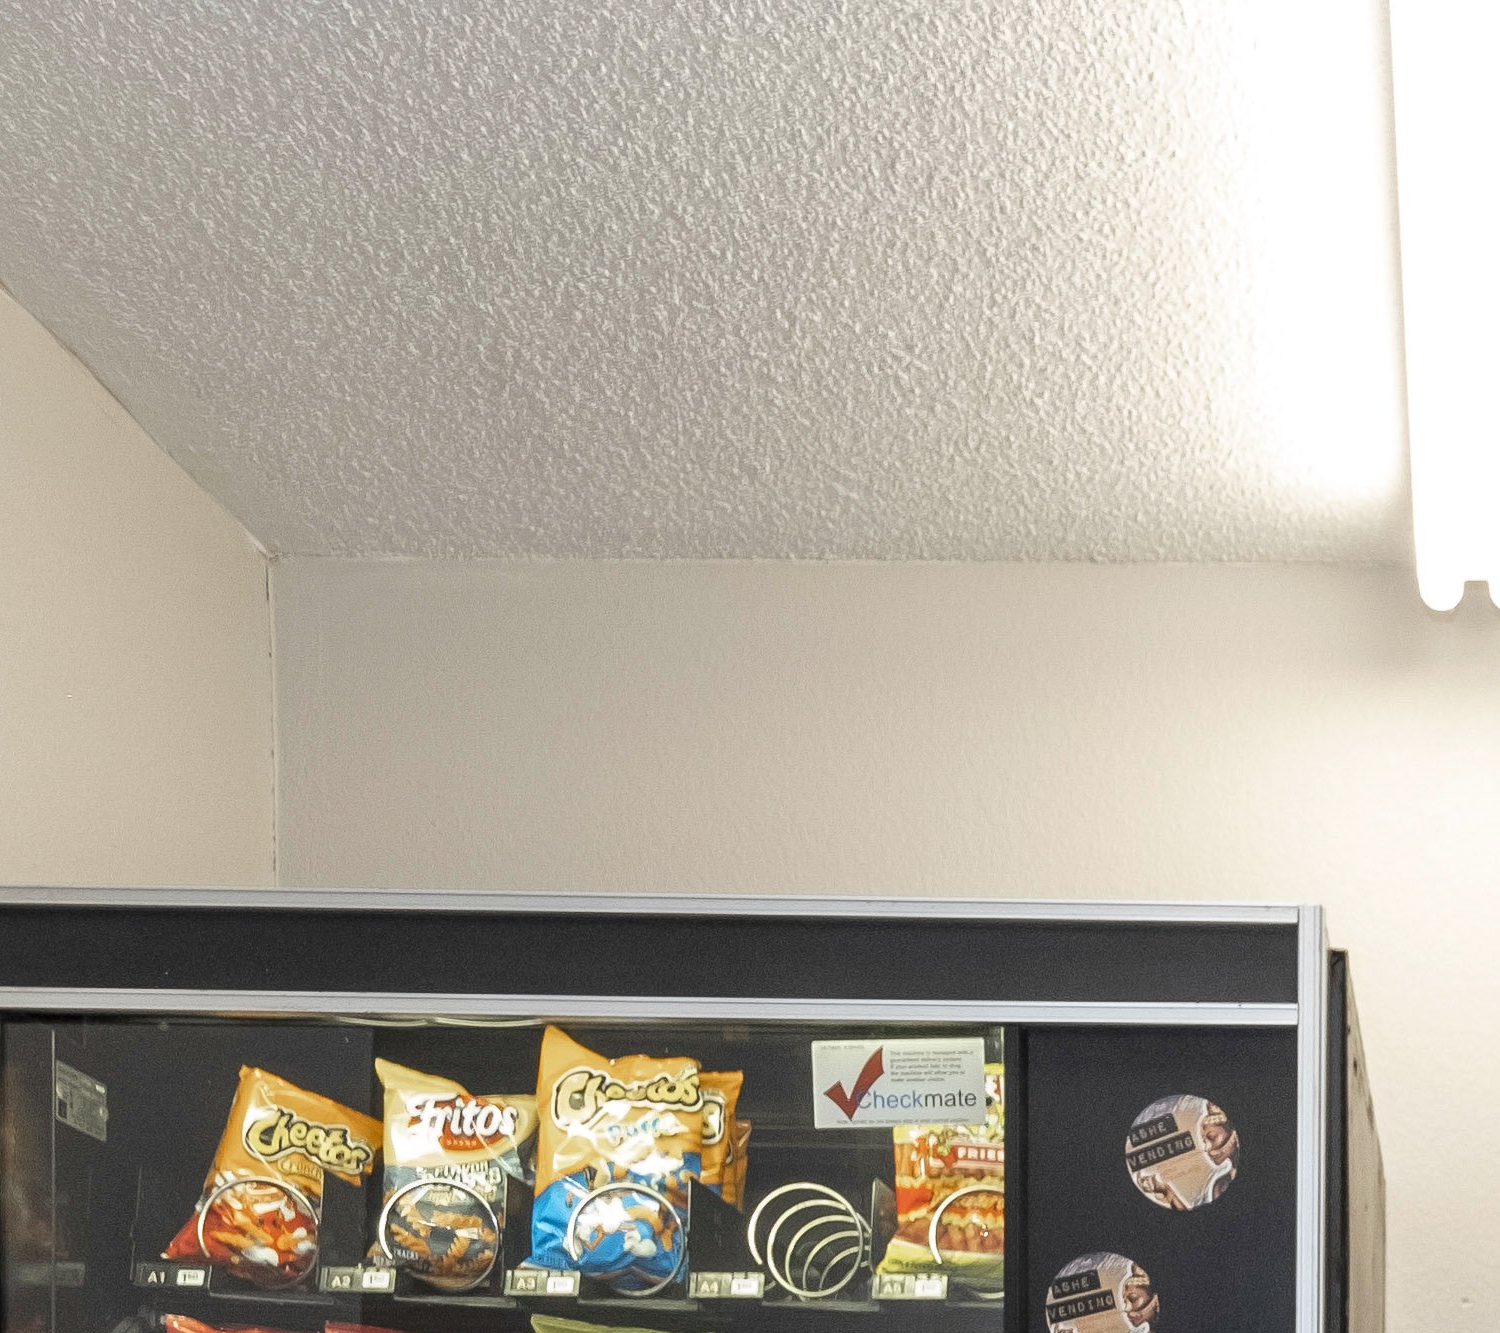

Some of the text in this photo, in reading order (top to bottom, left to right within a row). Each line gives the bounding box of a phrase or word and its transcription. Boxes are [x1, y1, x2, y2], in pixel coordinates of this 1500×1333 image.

[856, 1089, 977, 1110] Checkmate
[406, 1094, 519, 1137] Fritos
[247, 1109, 371, 1171] Cheetos
[1129, 1136, 1194, 1171] VENDING
[148, 1271, 165, 1284] A1
[700, 1281, 718, 1293] A4
[1049, 1293, 1114, 1320] VENDING
